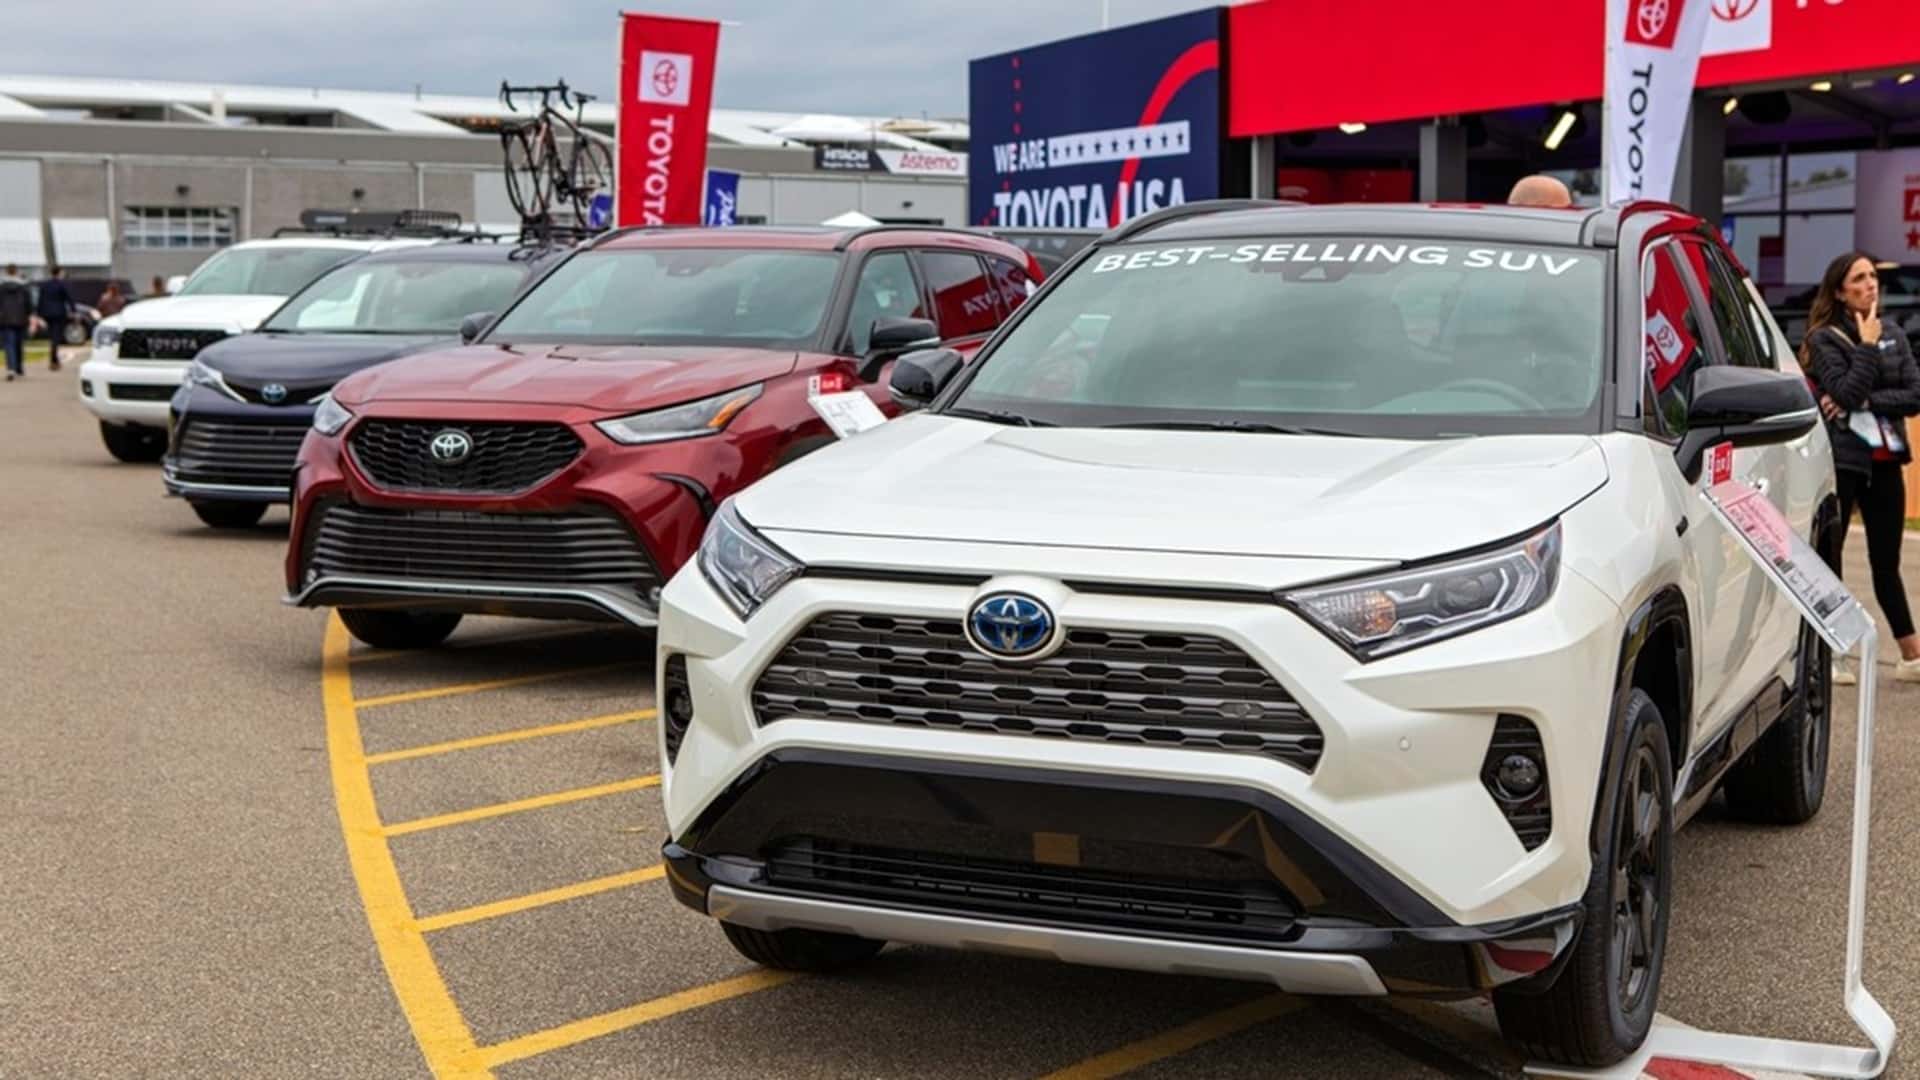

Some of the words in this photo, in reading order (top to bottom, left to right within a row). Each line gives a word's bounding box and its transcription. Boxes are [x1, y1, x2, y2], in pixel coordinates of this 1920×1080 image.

[1628, 63, 1653, 200] TOYOT
[900, 153, 960, 170] Astemo
[993, 143, 1018, 173] WE
[1019, 139, 1046, 171] ARE
[994, 184, 1109, 228] TOYOTA
[1093, 243, 1449, 273] BEST-SELLING
[1463, 249, 1580, 275] SUV
